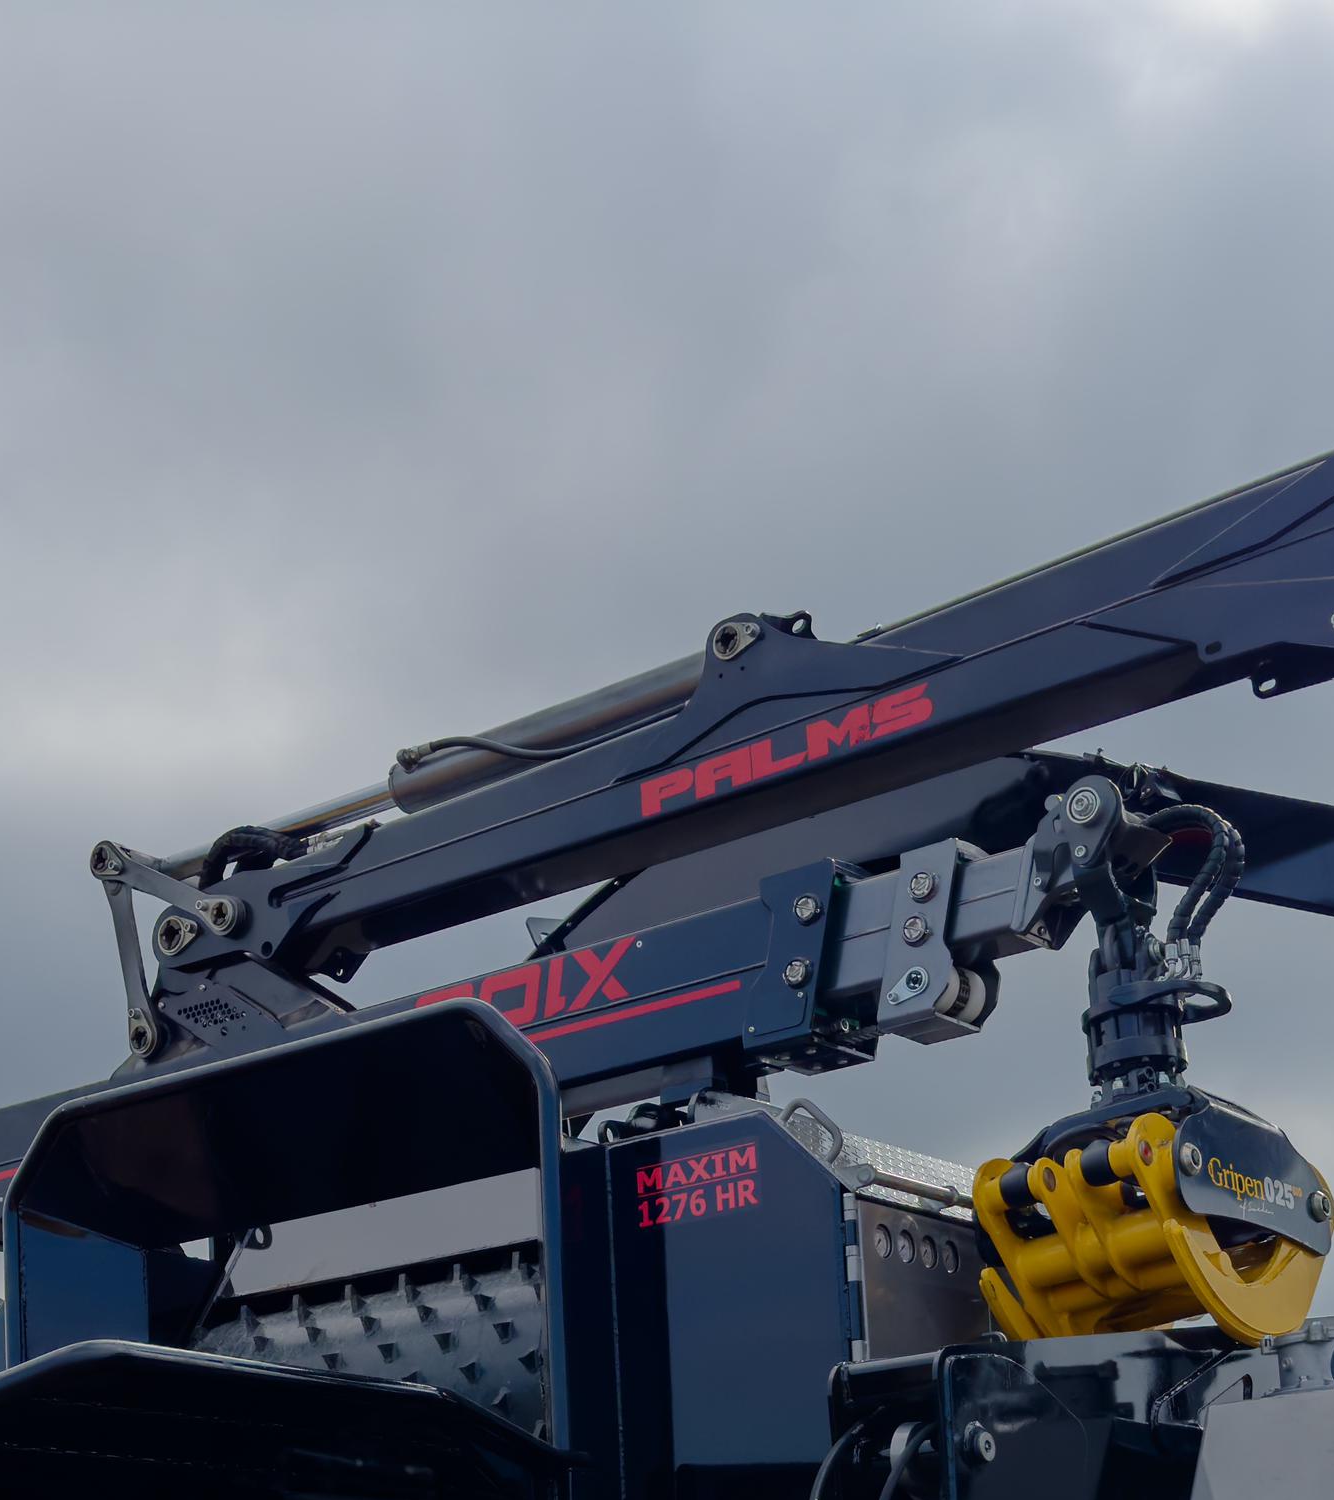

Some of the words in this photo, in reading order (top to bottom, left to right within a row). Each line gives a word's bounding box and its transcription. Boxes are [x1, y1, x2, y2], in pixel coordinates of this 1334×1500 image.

[640, 682, 933, 817] PALMS
[636, 1144, 758, 1194] MAXIM
[638, 1187, 706, 1228] 1276
[716, 1178, 759, 1212] HR
